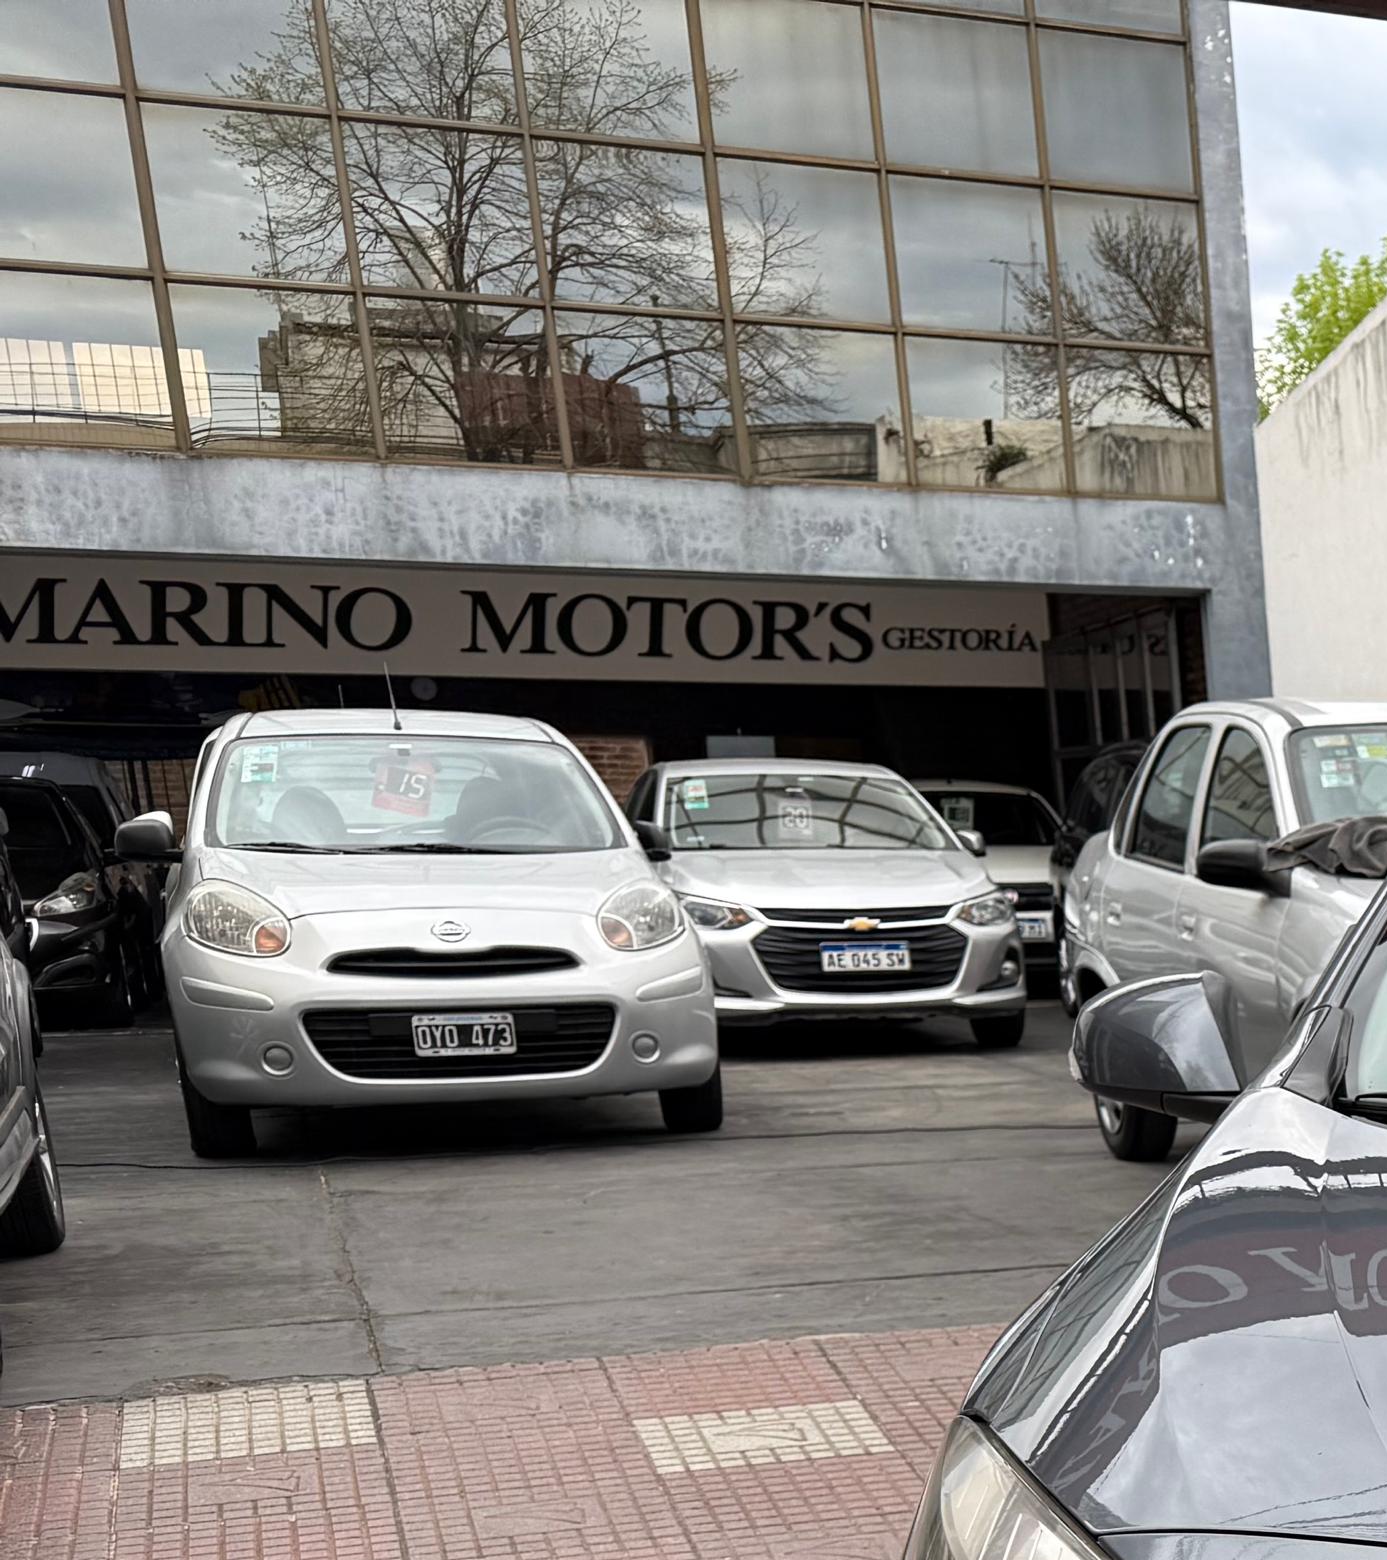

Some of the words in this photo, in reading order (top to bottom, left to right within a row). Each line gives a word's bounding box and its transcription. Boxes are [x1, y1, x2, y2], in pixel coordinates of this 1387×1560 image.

[0, 577, 412, 651] MARINO
[460, 590, 873, 664] MOTOR'S
[882, 623, 1038, 654] GESTORÍA
[827, 953, 846, 969] AE
[417, 1025, 459, 1049] OYO
[471, 1024, 512, 1047] 473
